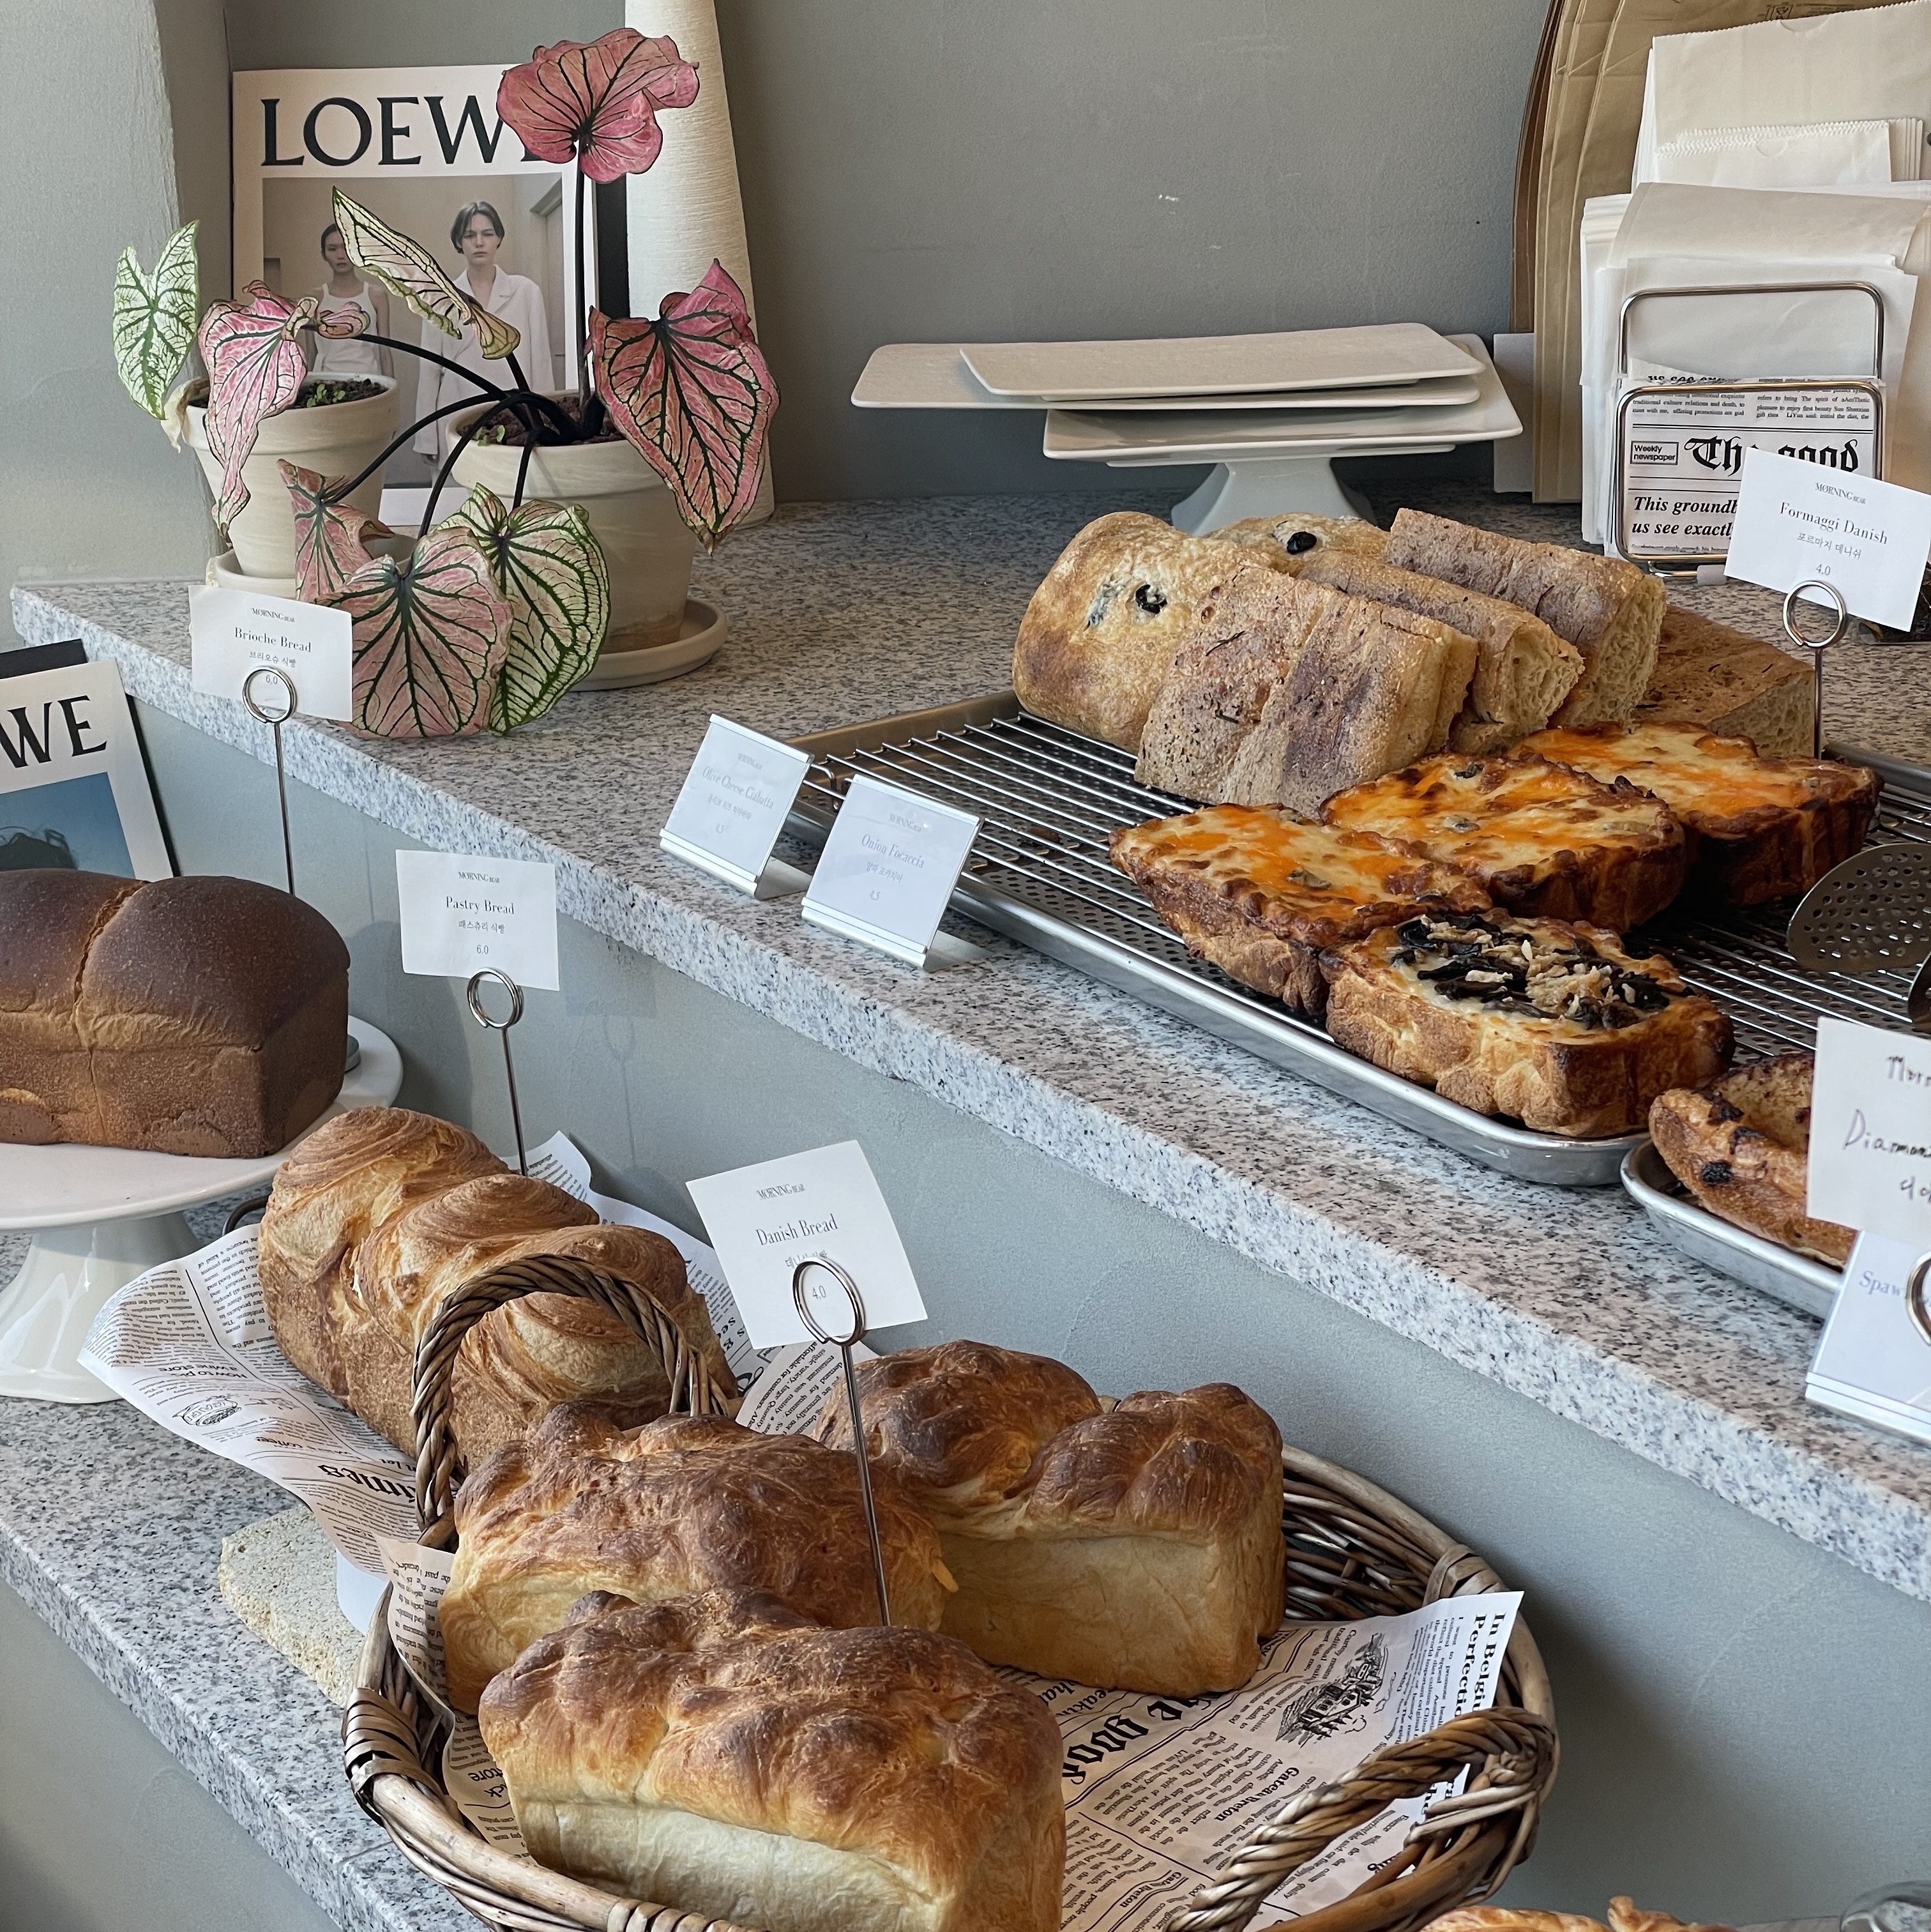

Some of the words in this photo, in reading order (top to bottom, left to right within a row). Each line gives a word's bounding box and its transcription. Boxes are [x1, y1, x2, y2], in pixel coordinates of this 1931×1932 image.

[261, 95, 541, 166] LOEW
[1634, 445, 1662, 453] Weekly
[1684, 436, 1759, 476] Th
[1633, 453, 1676, 462] newspaper
[1634, 496, 1668, 512] This
[1632, 523, 1650, 535] us
[1655, 523, 1678, 535] see
[1780, 502, 1840, 532] Formaggi
[1844, 520, 1888, 544] Danish
[1797, 532, 1832, 551] 포르마지
[1816, 563, 1831, 576] 4.0
[235, 627, 276, 645] Brioche
[280, 636, 312, 653] Bread
[250, 651, 279, 664] 브리오슈
[266, 674, 278, 685] 6.0
[702, 766, 721, 783] Olive
[721, 775, 745, 795] Cheese
[861, 833, 888, 854] Onion
[889, 844, 925, 869] Focaccia
[446, 896, 480, 915] Pastry
[484, 899, 515, 915] Bread
[476, 944, 489, 955] 6.0
[755, 1223, 799, 1245] Danish
[798, 1213, 838, 1236] Bread
[225, 1275, 246, 1289] product
[812, 1285, 826, 1300] 4.0
[227, 1302, 252, 1316] products
[789, 1341, 817, 1369] affordable
[808, 1349, 826, 1365] single
[780, 1369, 791, 1379] for
[820, 1362, 842, 1384] demand
[775, 1385, 790, 1400] large
[794, 1383, 806, 1392] was
[809, 1385, 819, 1394] for
[775, 1394, 794, 1414] mainly
[796, 1394, 822, 1420] generally
[785, 1420, 796, 1430] not
[1488, 1614, 1506, 1636] In
[1428, 1634, 1436, 1657] world
[1322, 1657, 1337, 1679] means
[1250, 1708, 1276, 1732] exquisite
[1421, 1707, 1430, 1733] China
[1160, 1777, 1178, 1789] spirit
[1210, 1769, 1234, 1788] original
[1149, 1795, 1170, 1811] perfect
[1182, 1794, 1194, 1803] and
[1094, 1802, 1106, 1811] the
[1158, 1802, 1181, 1818] content
[1214, 1797, 1260, 1821] Breton
[1127, 1810, 1149, 1827] system
[1190, 1809, 1211, 1825] reflect
[1243, 1817, 1254, 1825] the
[1139, 1825, 1150, 1834] the
[1149, 1826, 1169, 1841] world
[1176, 1826, 1188, 1834] the
[1231, 1825, 1245, 1834] fine
[1213, 1834, 1232, 1847] words
[1063, 1860, 1086, 1875] living
[1089, 1862, 1105, 1870] with
[1076, 1871, 1089, 1880] the
[1086, 1869, 1111, 1884] health,
[1119, 1885, 1152, 1908] Breton
[1188, 1883, 1206, 1897] food
[1284, 1883, 1306, 1899] quality
[1075, 1894, 1098, 1915] people
